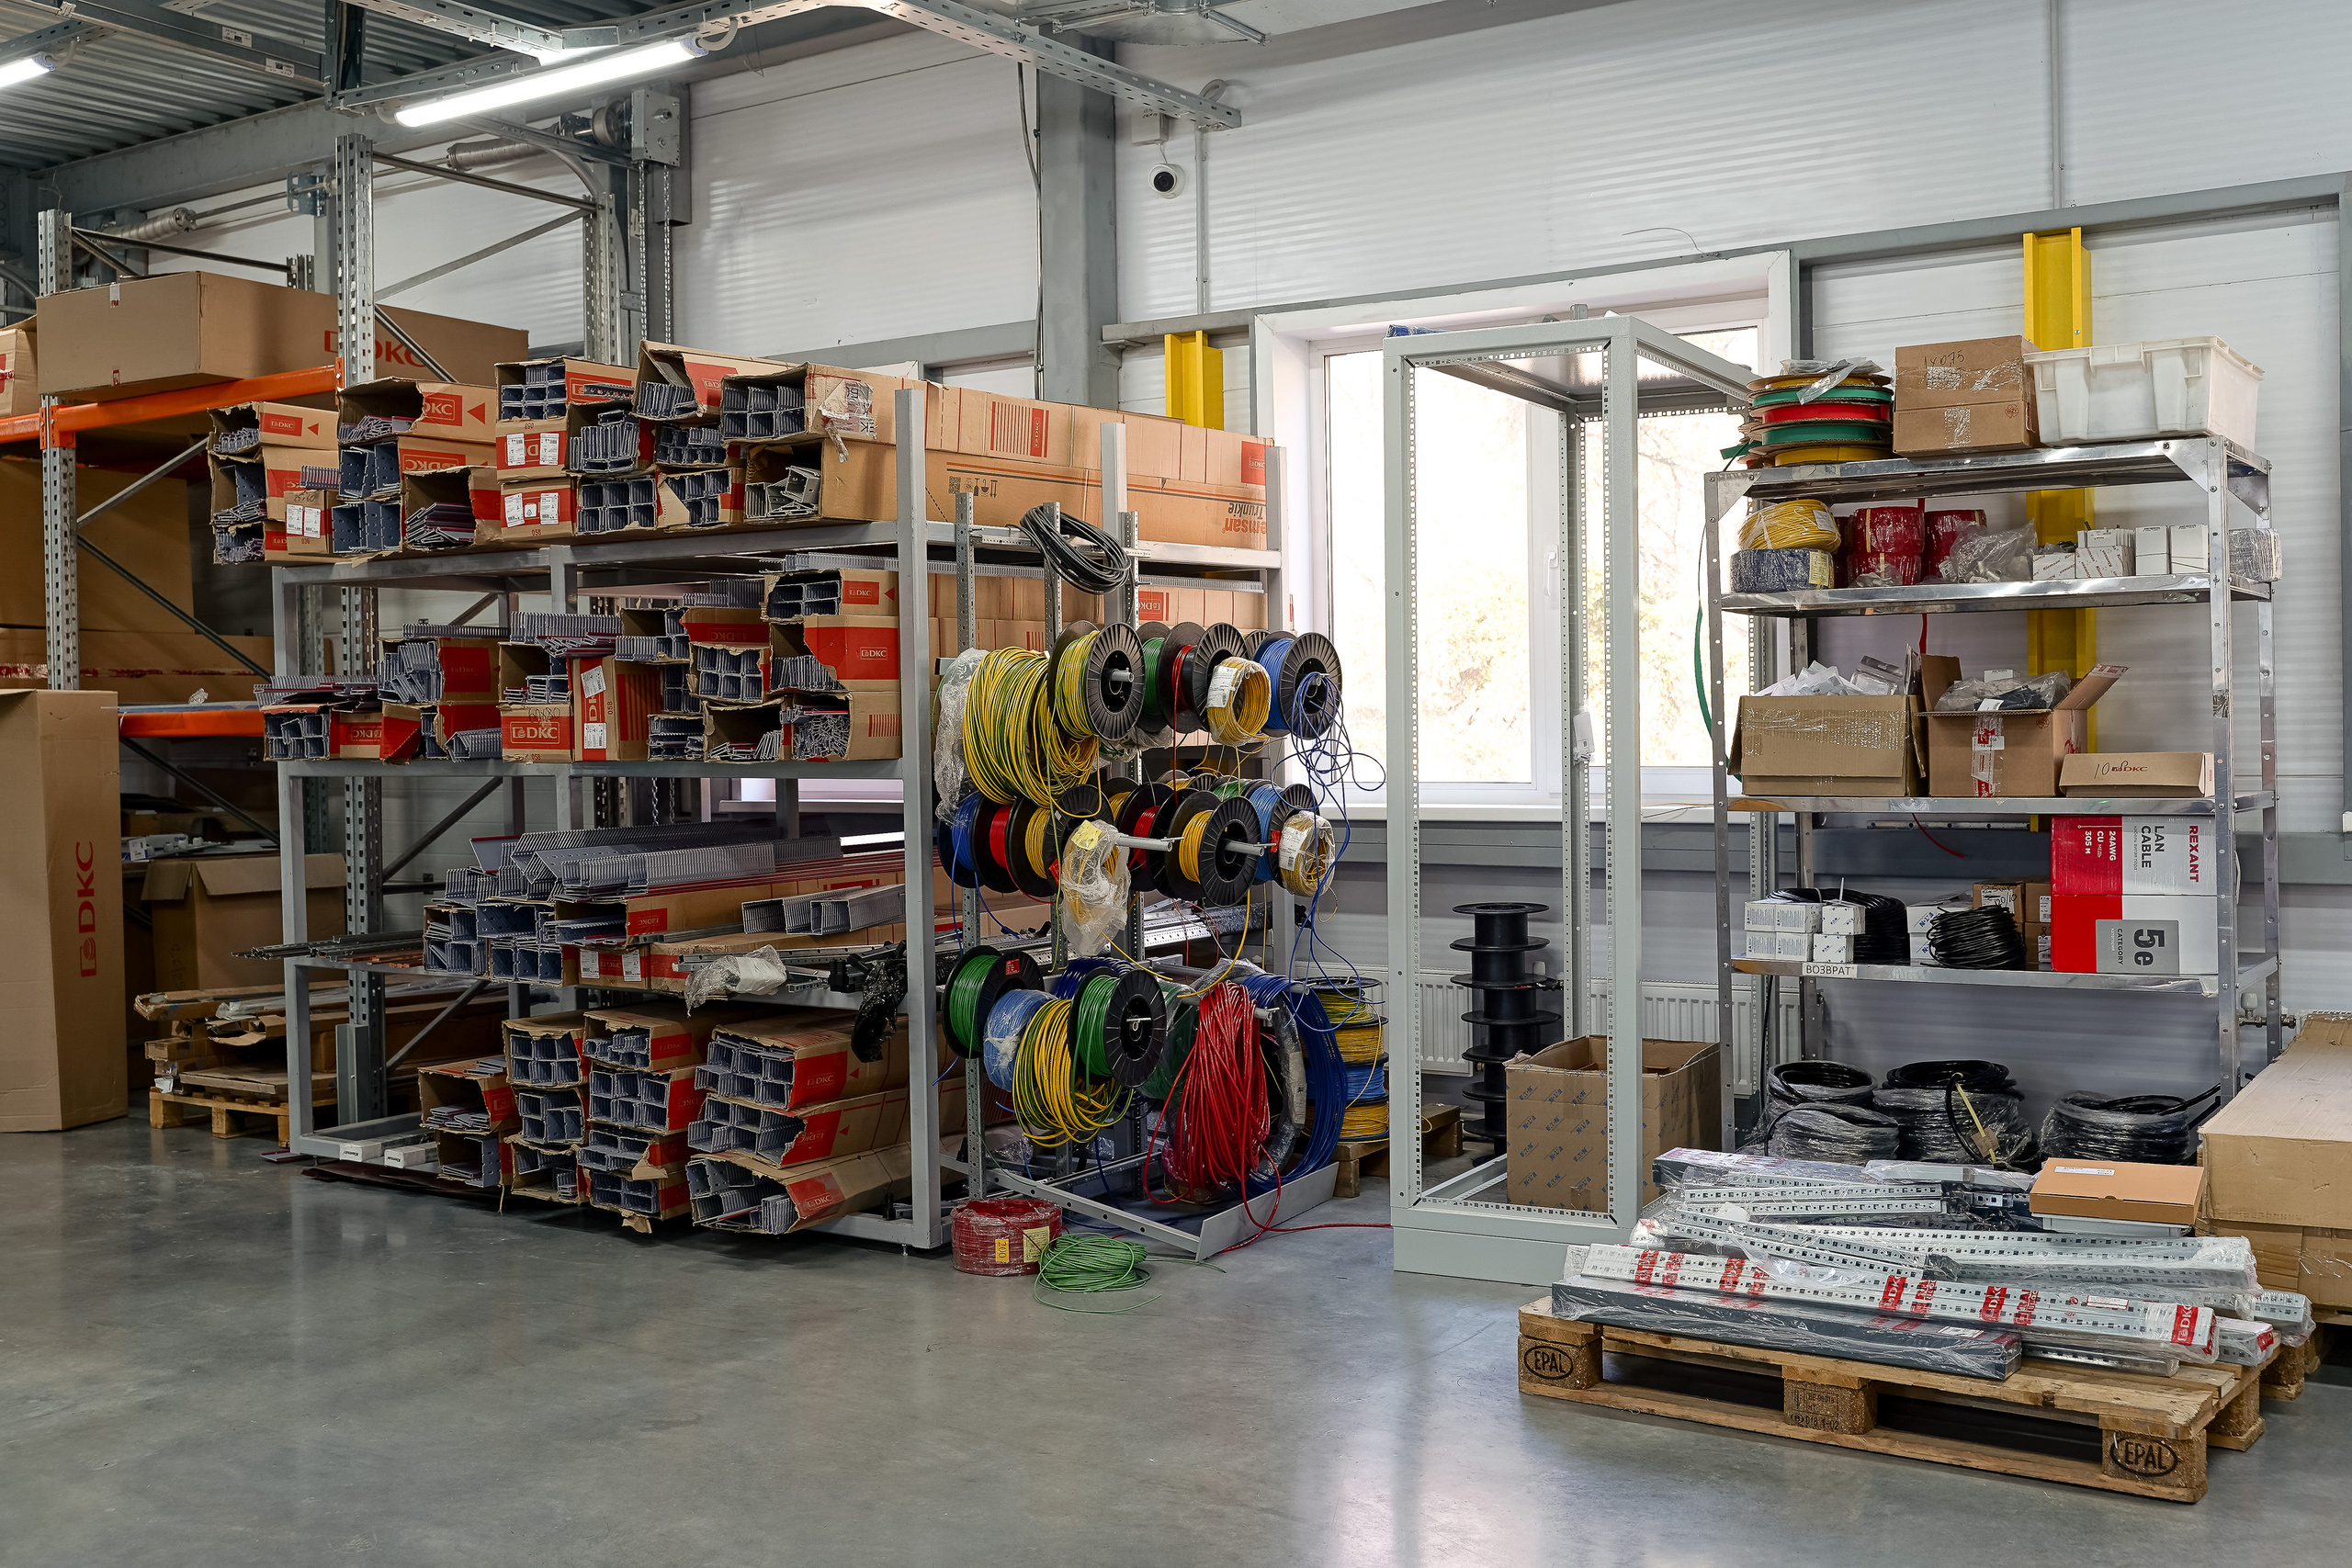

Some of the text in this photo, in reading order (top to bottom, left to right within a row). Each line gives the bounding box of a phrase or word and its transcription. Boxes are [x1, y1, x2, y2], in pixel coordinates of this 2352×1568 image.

[277, 421, 294, 429] DKC
[1227, 502, 1263, 520] Trunkie
[531, 528, 542, 536] 058
[1138, 602, 1152, 610] DK
[710, 631, 735, 641] DKC
[869, 649, 887, 658] DKC
[353, 729, 374, 739] DKC
[526, 727, 558, 739] DKC
[2085, 830, 2093, 847] 305
[2097, 830, 2104, 843] CU
[2154, 825, 2165, 852] LAN
[2109, 830, 2117, 861] 24AWG
[2141, 825, 2152, 868] CABLE
[2188, 825, 2199, 883] REXANT
[76, 841, 96, 934] DKC
[2133, 928, 2165, 966] 5e
[1805, 964, 1851, 976] ВОЗВРАТ
[816, 1075, 834, 1085] DKC
[815, 1194, 832, 1205] DKC
[998, 1241, 1008, 1258] 200
[1534, 1350, 1566, 1373] EPAL
[2124, 1441, 2167, 1471] EPAL
